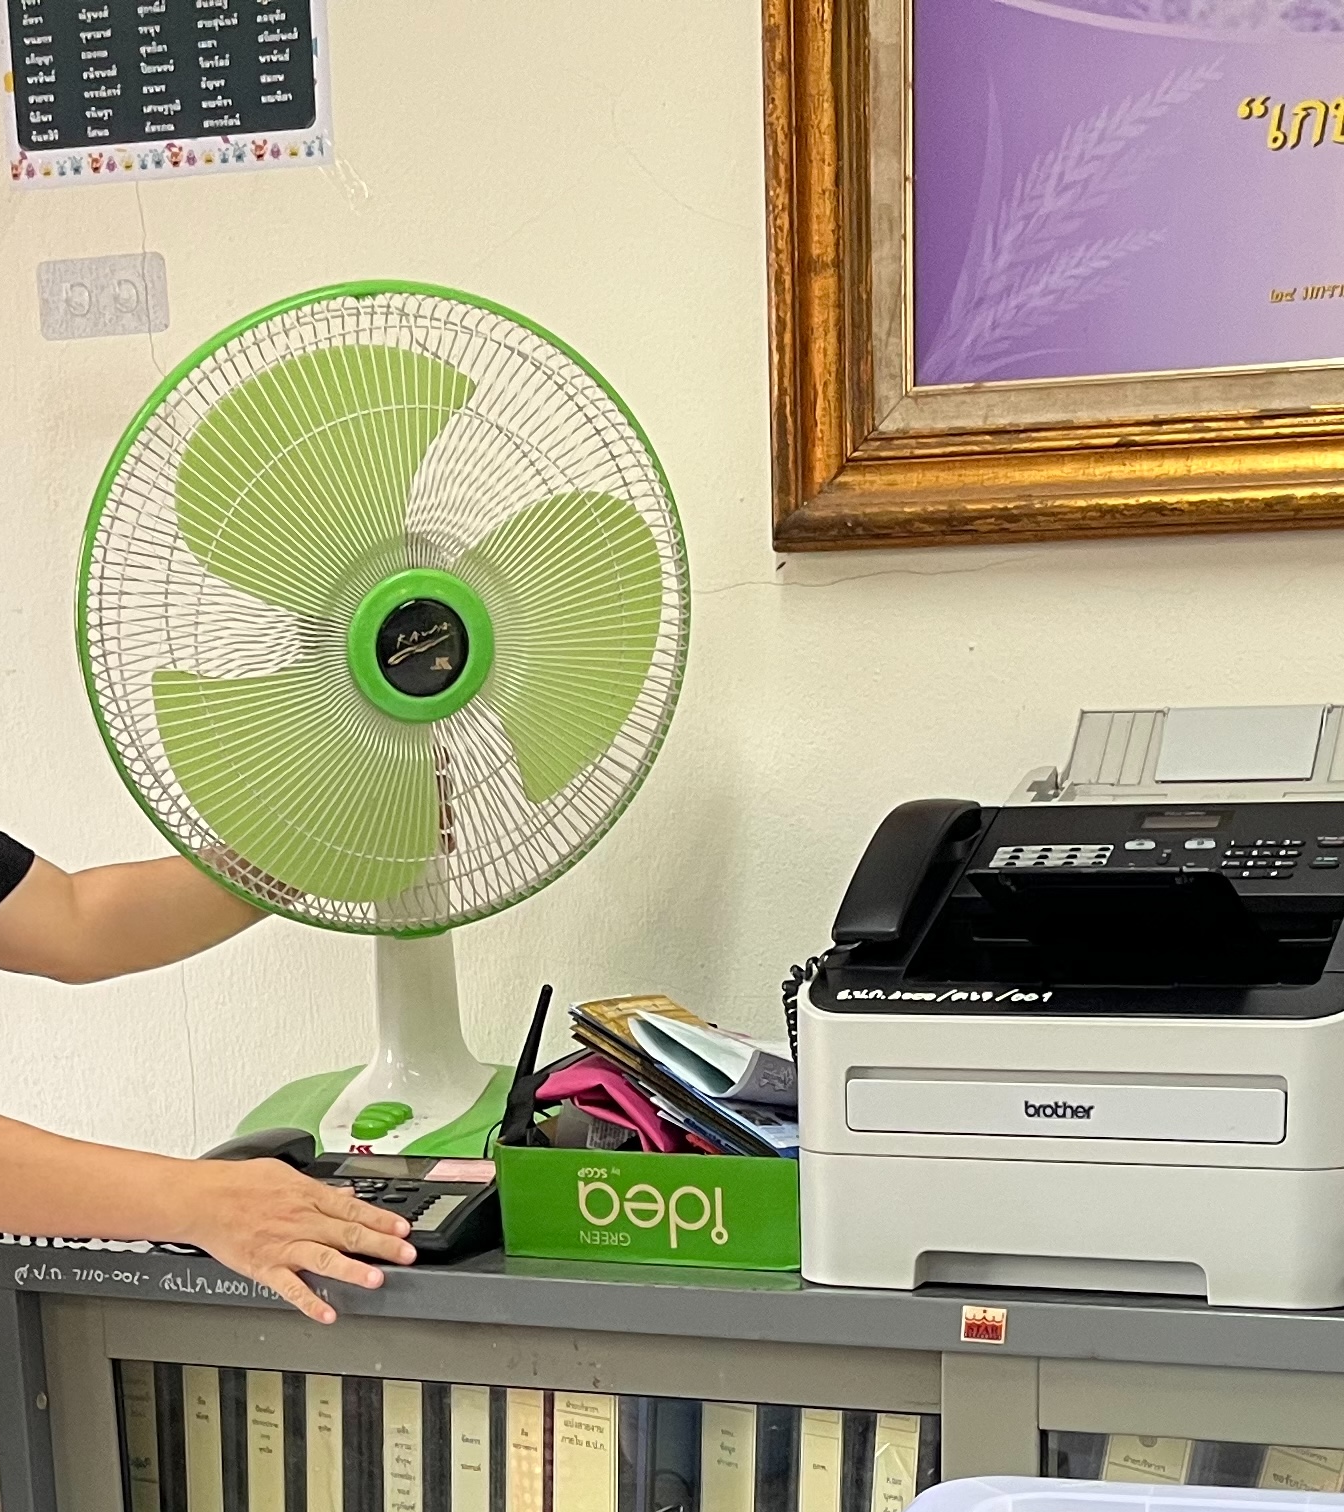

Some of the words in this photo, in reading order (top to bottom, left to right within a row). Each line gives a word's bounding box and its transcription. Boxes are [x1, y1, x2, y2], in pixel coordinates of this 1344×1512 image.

[1024, 1100, 1096, 1120] brother
[578, 1167, 609, 1179] SCGP
[577, 1180, 730, 1249] idea
[580, 1230, 631, 1247] GREEN
